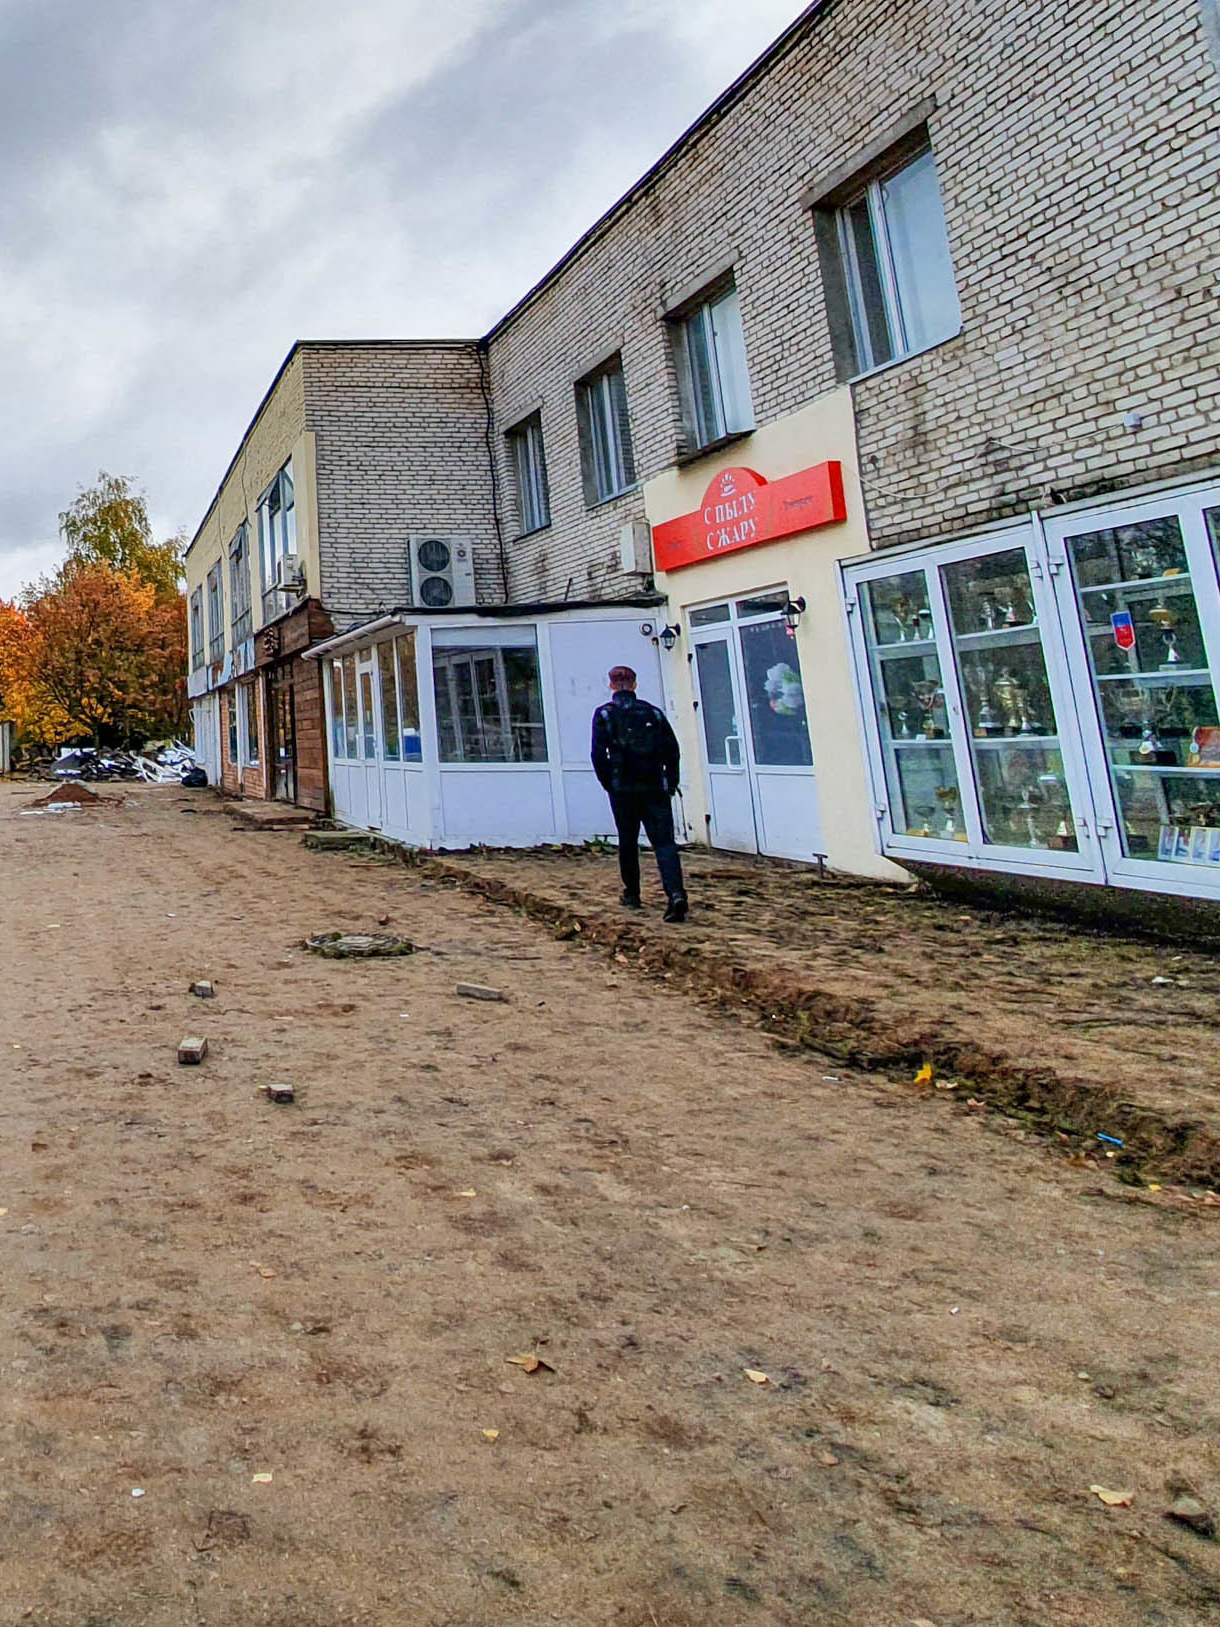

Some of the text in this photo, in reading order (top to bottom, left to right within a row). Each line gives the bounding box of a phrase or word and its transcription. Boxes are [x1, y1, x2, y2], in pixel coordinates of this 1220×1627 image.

[704, 507, 712, 525] С
[715, 491, 756, 524] ПЫЛУ
[706, 532, 715, 550] С
[716, 517, 758, 548] ЖАРУ
